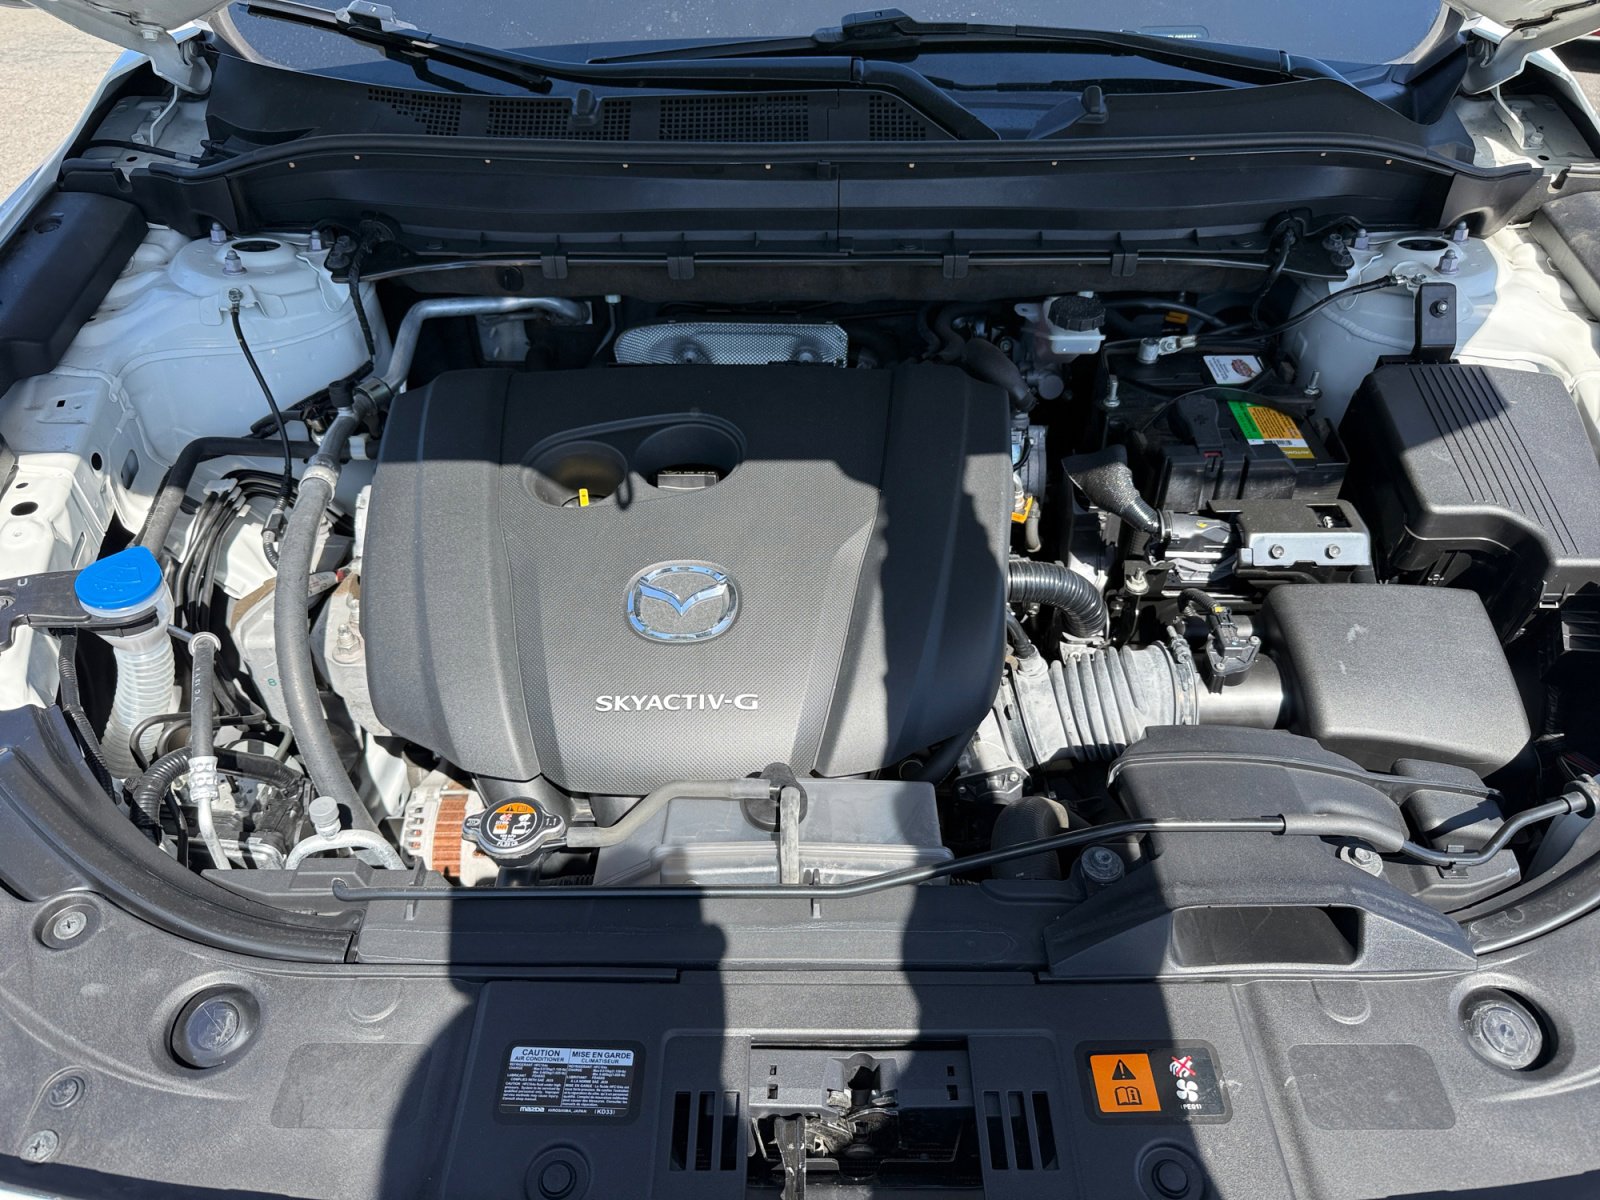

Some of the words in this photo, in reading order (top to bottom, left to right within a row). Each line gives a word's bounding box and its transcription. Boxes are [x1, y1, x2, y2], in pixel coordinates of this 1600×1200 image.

[595, 693, 759, 712] SKYACTIV-G
[522, 1048, 560, 1057] CAUTION
[604, 1052, 632, 1060] GARDE
